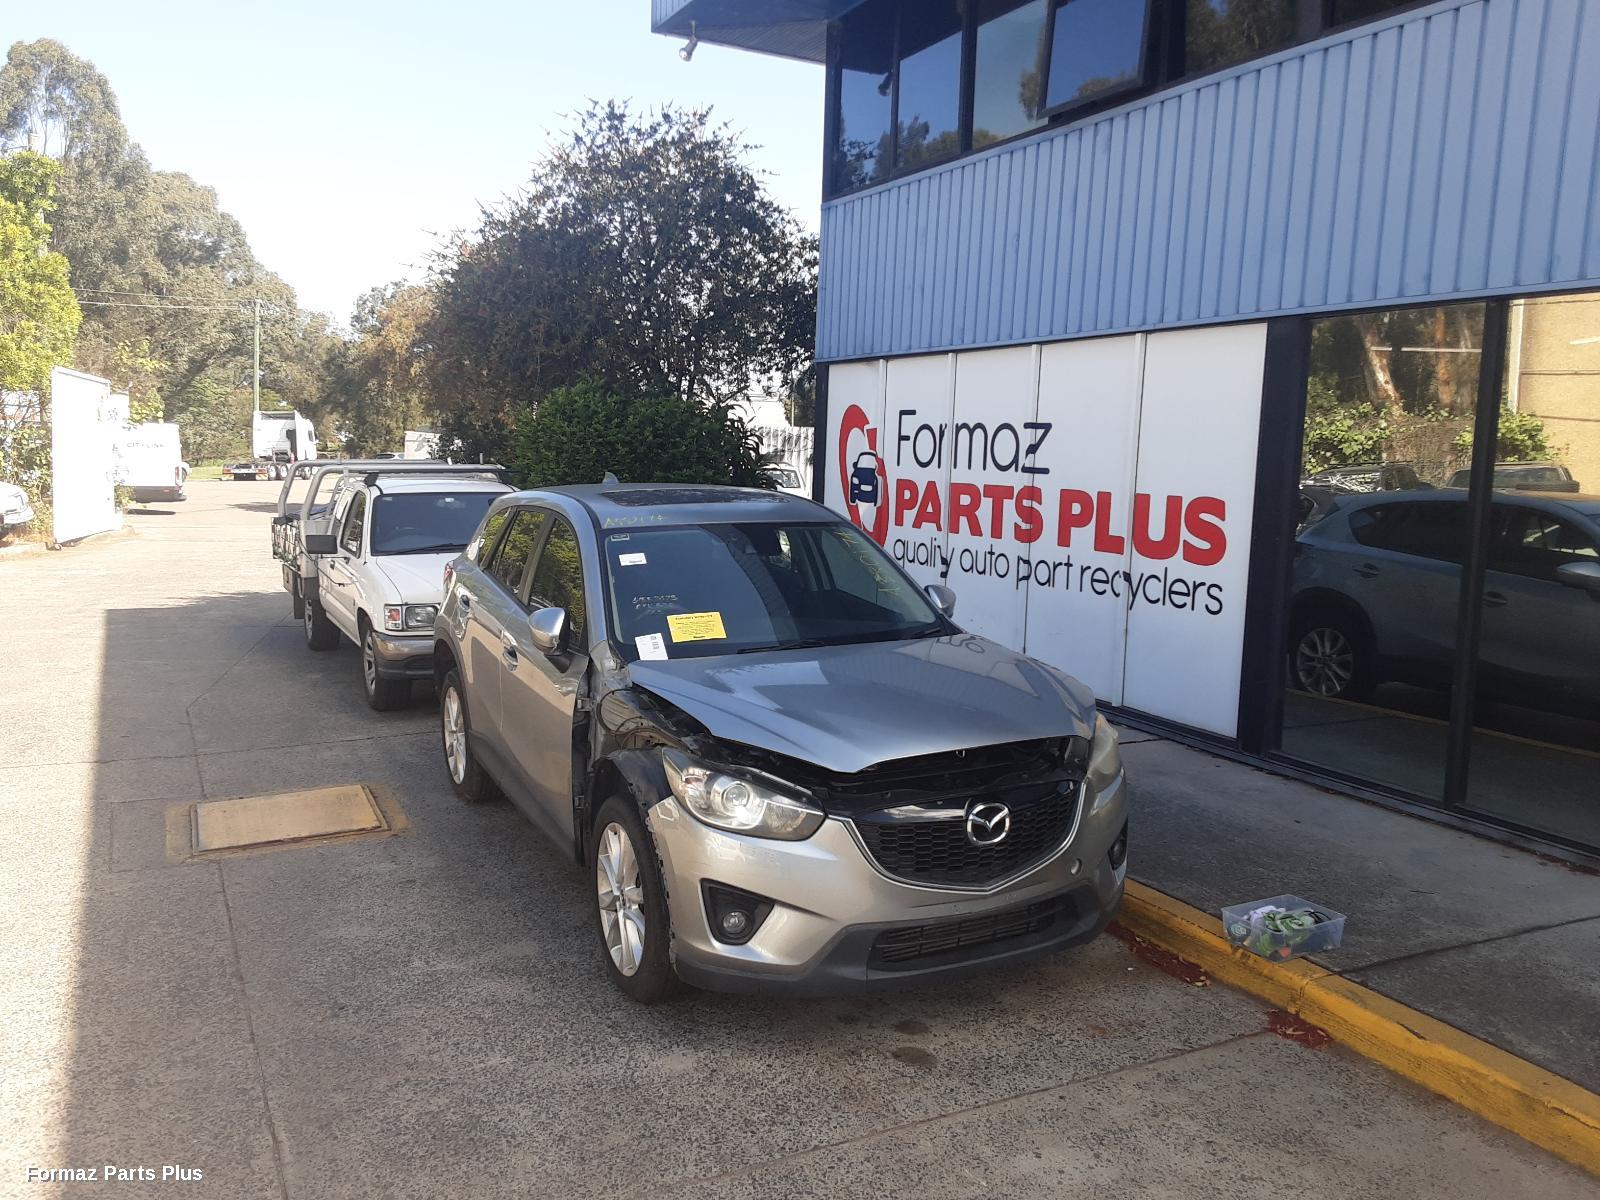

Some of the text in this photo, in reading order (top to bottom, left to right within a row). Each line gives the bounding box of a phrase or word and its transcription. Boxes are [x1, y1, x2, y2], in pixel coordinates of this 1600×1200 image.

[895, 408, 1053, 474] Formaz
[894, 479, 1227, 567] PARTS PLUS
[893, 537, 955, 579] qualiy
[959, 544, 1010, 579] auto
[1016, 555, 1073, 590] part
[1079, 563, 1223, 616] recyclers
